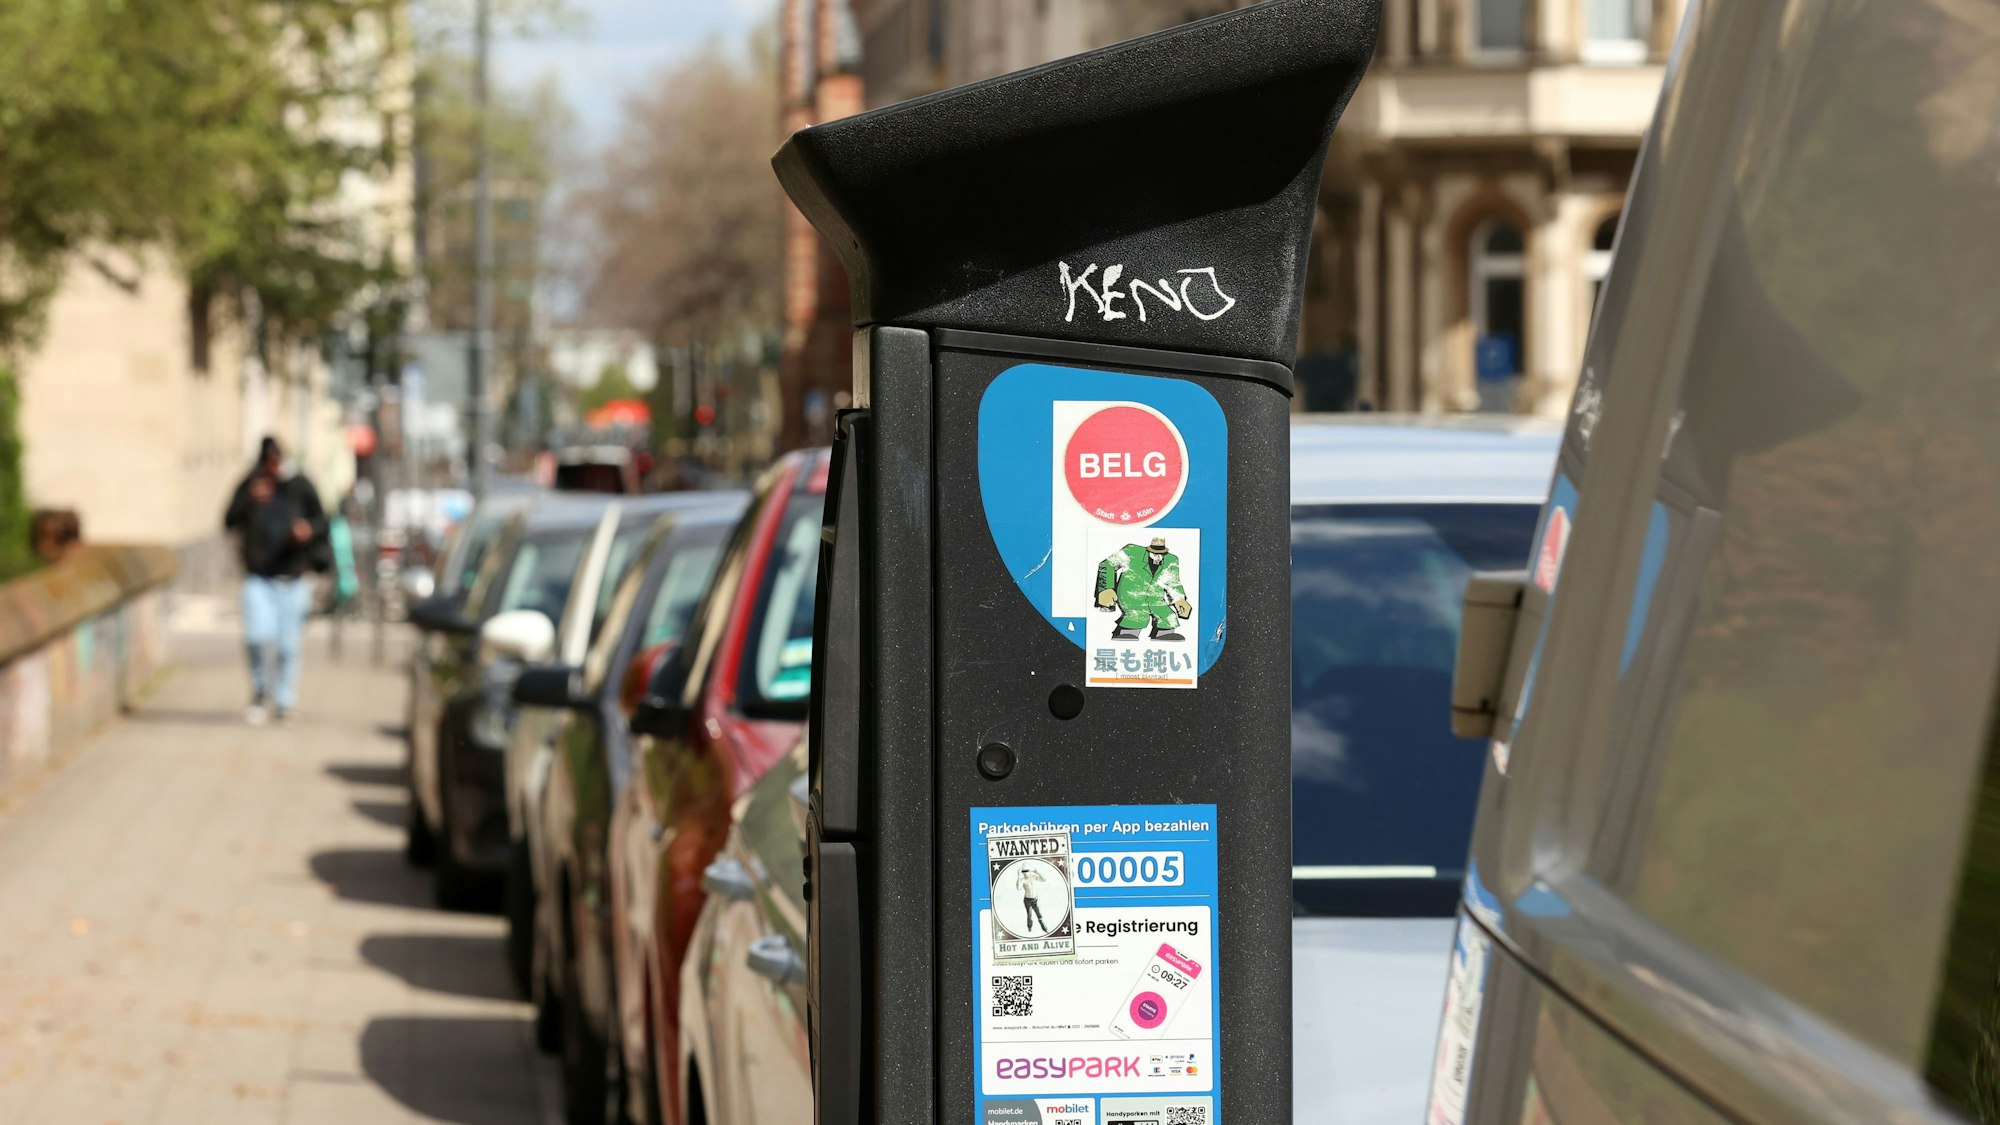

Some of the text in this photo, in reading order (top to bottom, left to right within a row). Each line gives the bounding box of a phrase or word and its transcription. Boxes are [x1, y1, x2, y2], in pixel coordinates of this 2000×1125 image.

[1079, 451, 1167, 478] BELG
[1095, 507, 1155, 519] Stadt Köln
[1094, 648, 1192, 673] 最も鈍い
[978, 820, 1210, 836] Parkgebühren per App bezahlen
[996, 838, 1060, 857] WANTED
[1072, 856, 1179, 884] 00005
[1086, 918, 1199, 938] Registrierung
[999, 941, 1070, 953] HOT AND ALIVE
[1095, 957, 1119, 966] parken
[1160, 970, 1188, 990] 09:27
[987, 1107, 1023, 1115] mobilet.de
[1046, 1103, 1089, 1114] mobilet
